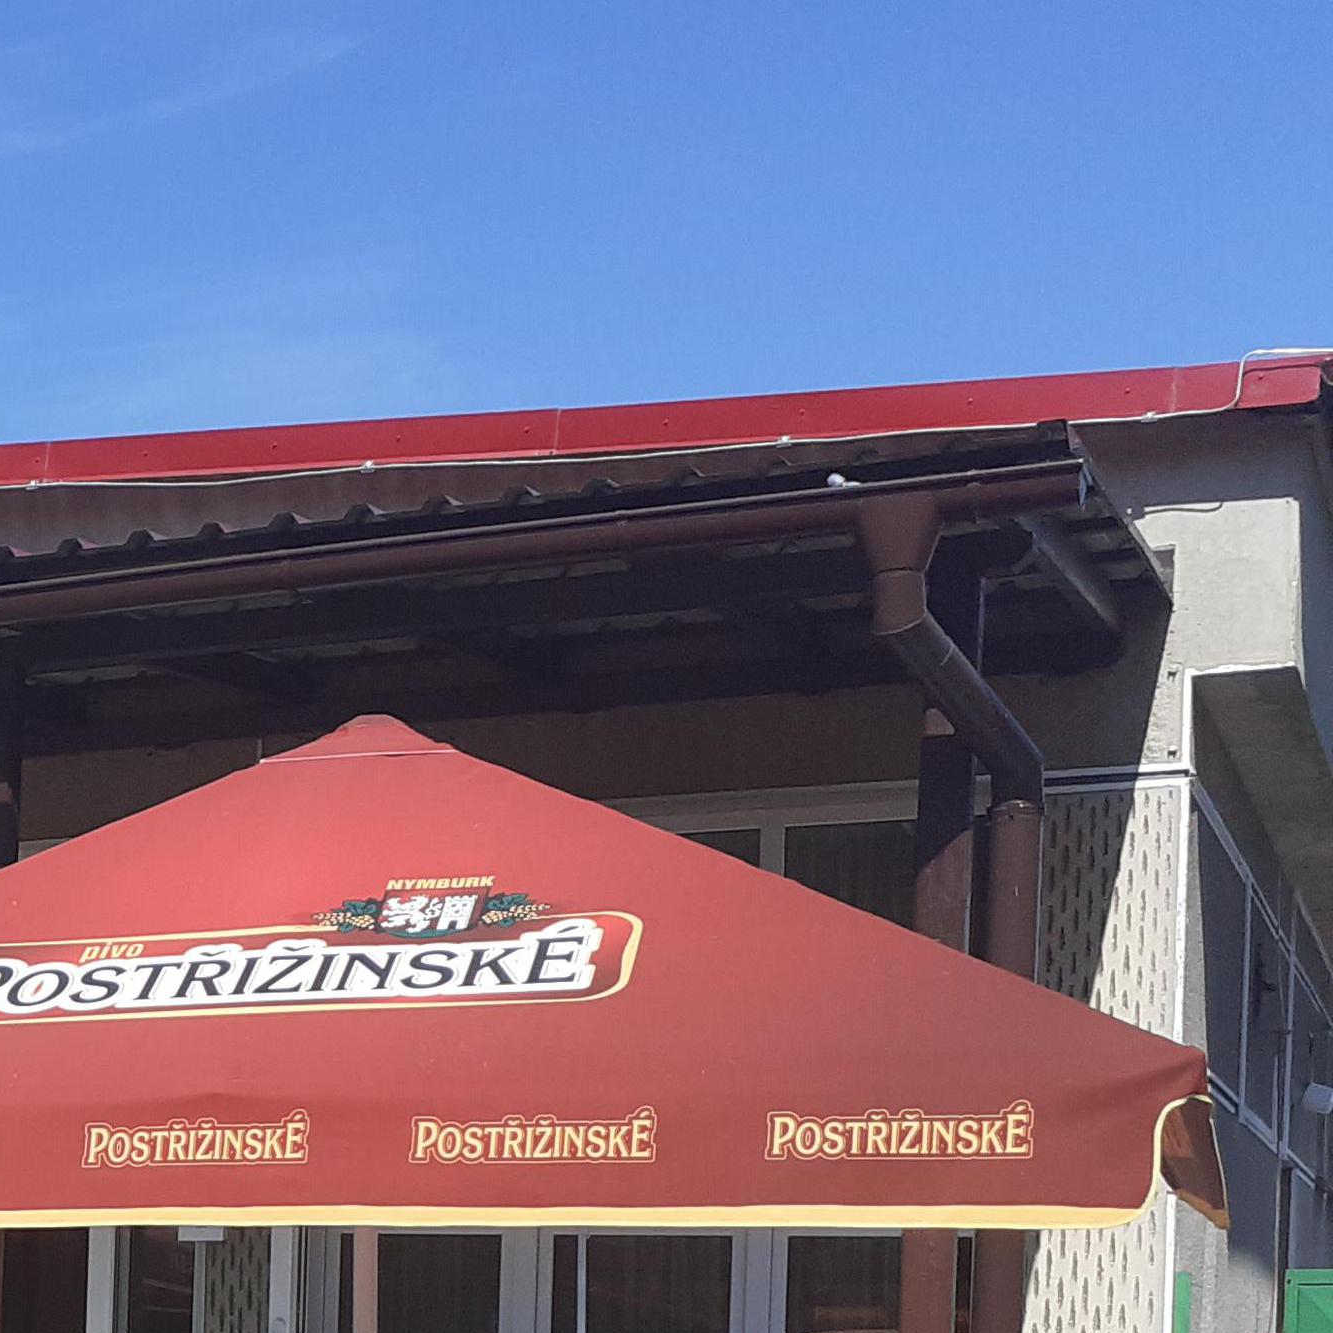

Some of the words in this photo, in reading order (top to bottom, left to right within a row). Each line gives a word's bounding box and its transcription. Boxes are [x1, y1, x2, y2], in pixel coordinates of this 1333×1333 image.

[385, 875, 495, 891] NYMBURK
[78, 941, 145, 964] pivo
[85, 1111, 307, 1165] POSTŘIŽINSKÉ
[416, 1107, 654, 1159] POSTŘIŽINSKÉ
[771, 1101, 1032, 1157] POSTŘIŽINSKÉ
